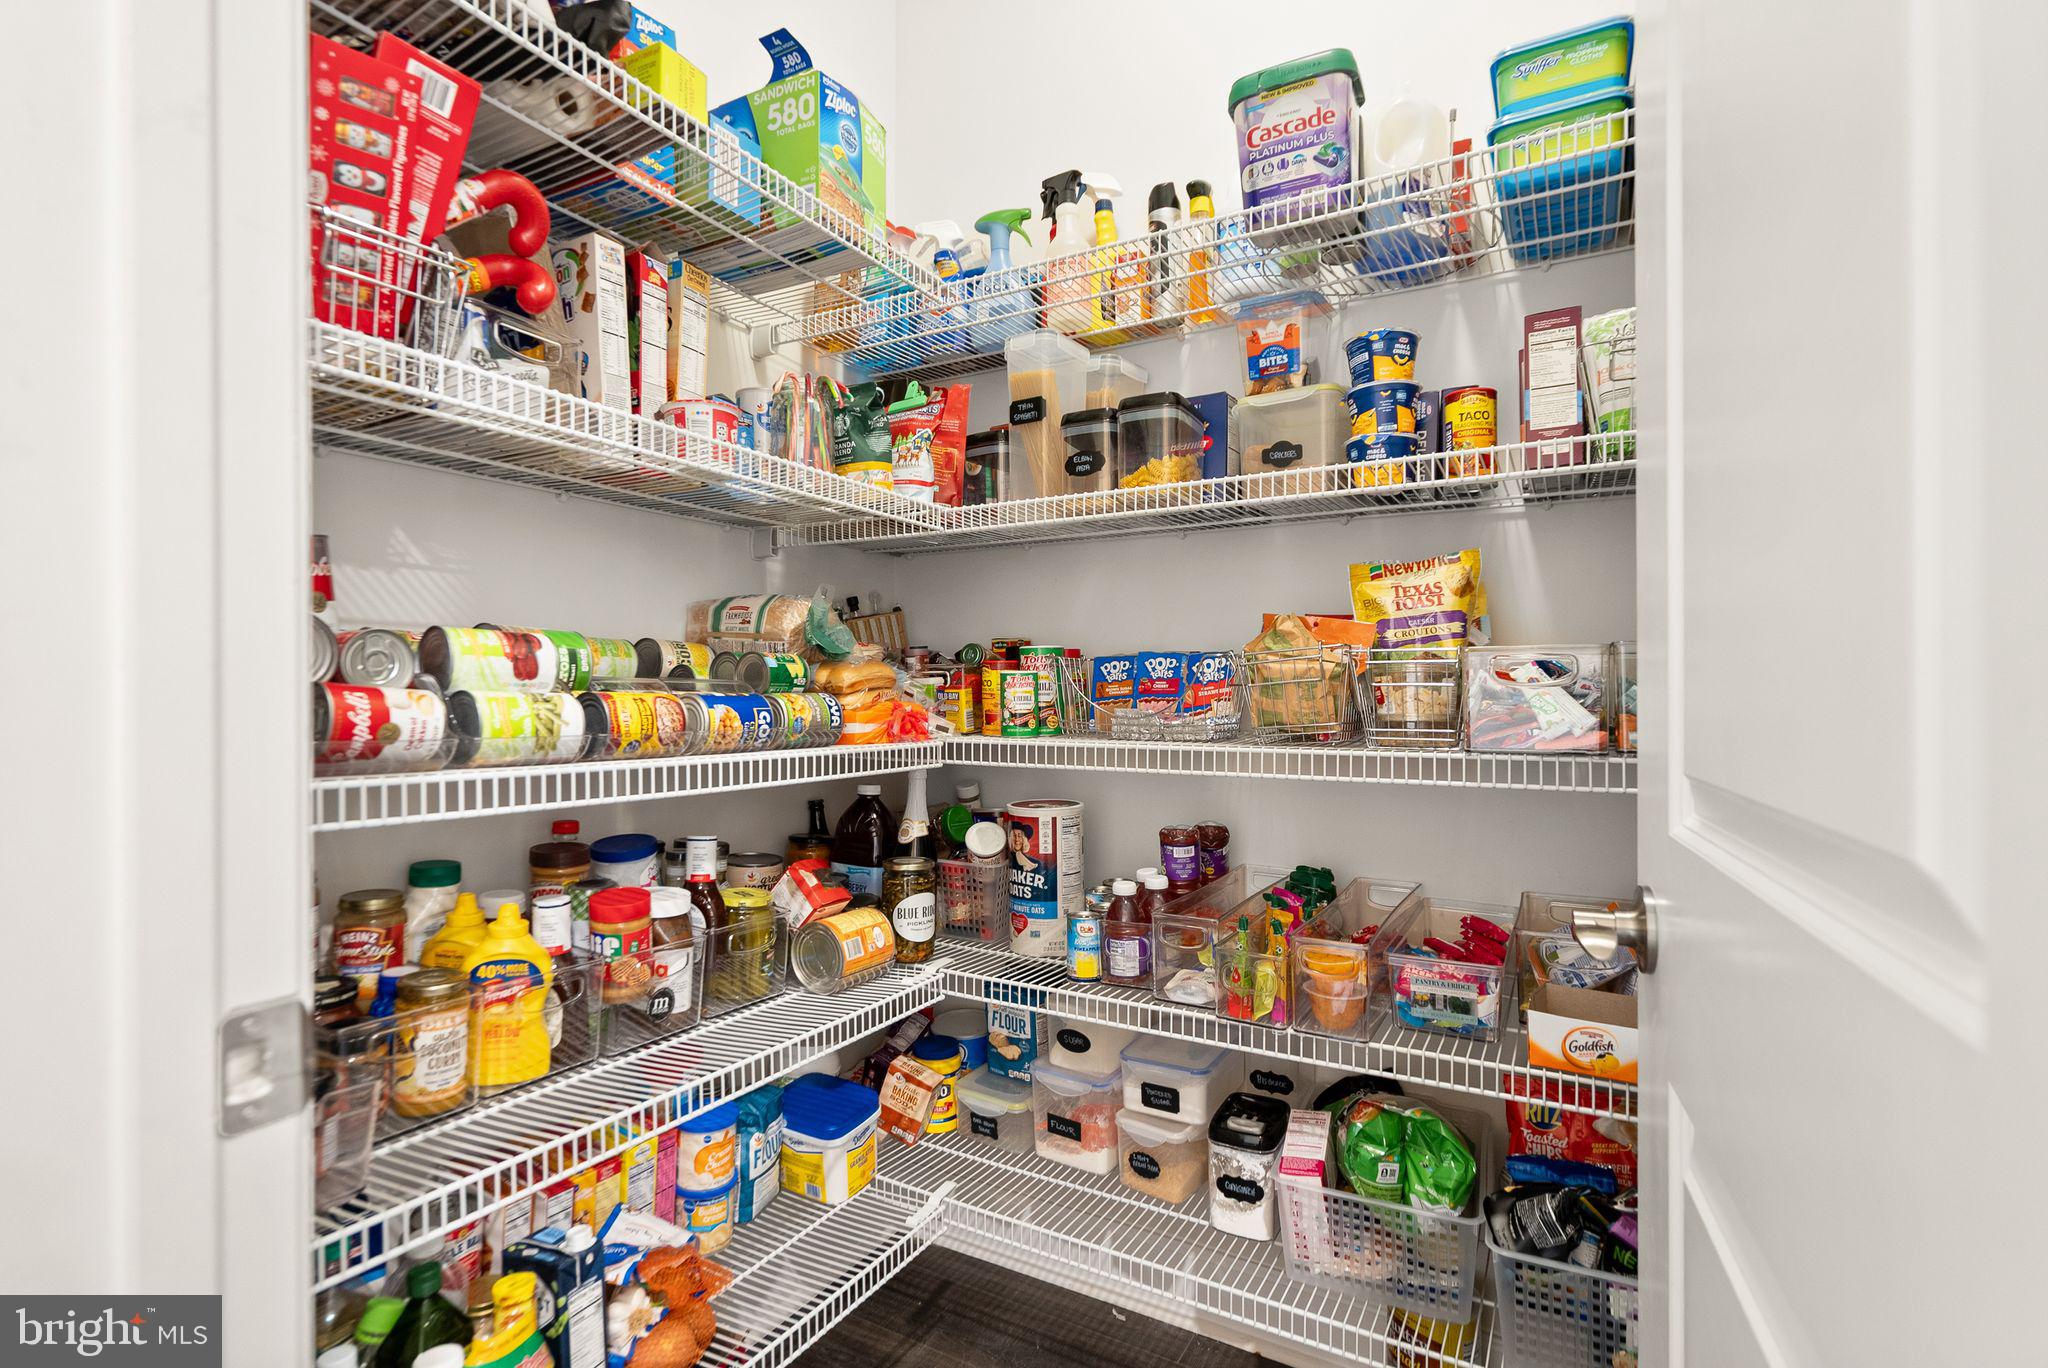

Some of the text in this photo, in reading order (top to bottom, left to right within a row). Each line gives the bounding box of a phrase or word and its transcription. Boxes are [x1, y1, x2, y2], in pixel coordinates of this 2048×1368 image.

[635, 13, 664, 36] Ziploc
[772, 36, 782, 46] 4
[1566, 43, 1609, 59] MOPPING
[1569, 51, 1604, 65] CLOTHS
[782, 52, 801, 69] 580
[1511, 54, 1563, 80] Swiffer
[754, 75, 816, 106] SANDWICH
[1261, 91, 1276, 101] NEW
[1281, 80, 1315, 95] IMPROVED
[767, 92, 815, 131] 580
[825, 89, 857, 118] Ziploc
[776, 120, 816, 137] TOTAL BAGS
[1247, 107, 1336, 149] Cascade
[392, 125, 409, 169] Figurines
[1249, 130, 1335, 162] PLATINUM PLUS
[387, 170, 403, 210] Flavored
[380, 254, 395, 295] Asorted
[685, 264, 708, 282] Cheerios
[1259, 354, 1288, 367] BITES
[1459, 410, 1490, 421] TACO
[1418, 431, 1427, 482] DELXE
[1391, 582, 1443, 598] TEXAS
[1363, 598, 1382, 608] BIG
[1392, 593, 1445, 611] TOAST
[1408, 617, 1435, 626] CAESAR
[1394, 625, 1452, 639] CROUTONS
[937, 692, 960, 700] OLD BAY
[1009, 869, 1044, 889] AKER
[897, 905, 935, 920] BLUE RID
[1031, 907, 1045, 915] OATS
[907, 919, 934, 927] PICKLING
[1080, 926, 1095, 935] Dole
[341, 931, 379, 944] HEINZ
[1415, 977, 1440, 986] PANTRY
[1446, 982, 1472, 991] FRIDGE
[991, 1010, 1027, 1035] FLOUR
[1062, 1034, 1086, 1048] SUGAR
[1568, 1039, 1614, 1053] Goldfish
[892, 1085, 918, 1106] BAKING
[1525, 1102, 1563, 1127] RITZ
[1050, 1120, 1076, 1137] FLOUR
[1520, 1127, 1568, 1149] Toasted
[753, 1129, 783, 1170] FLOUR
[1525, 1144, 1564, 1160] CHIPS
